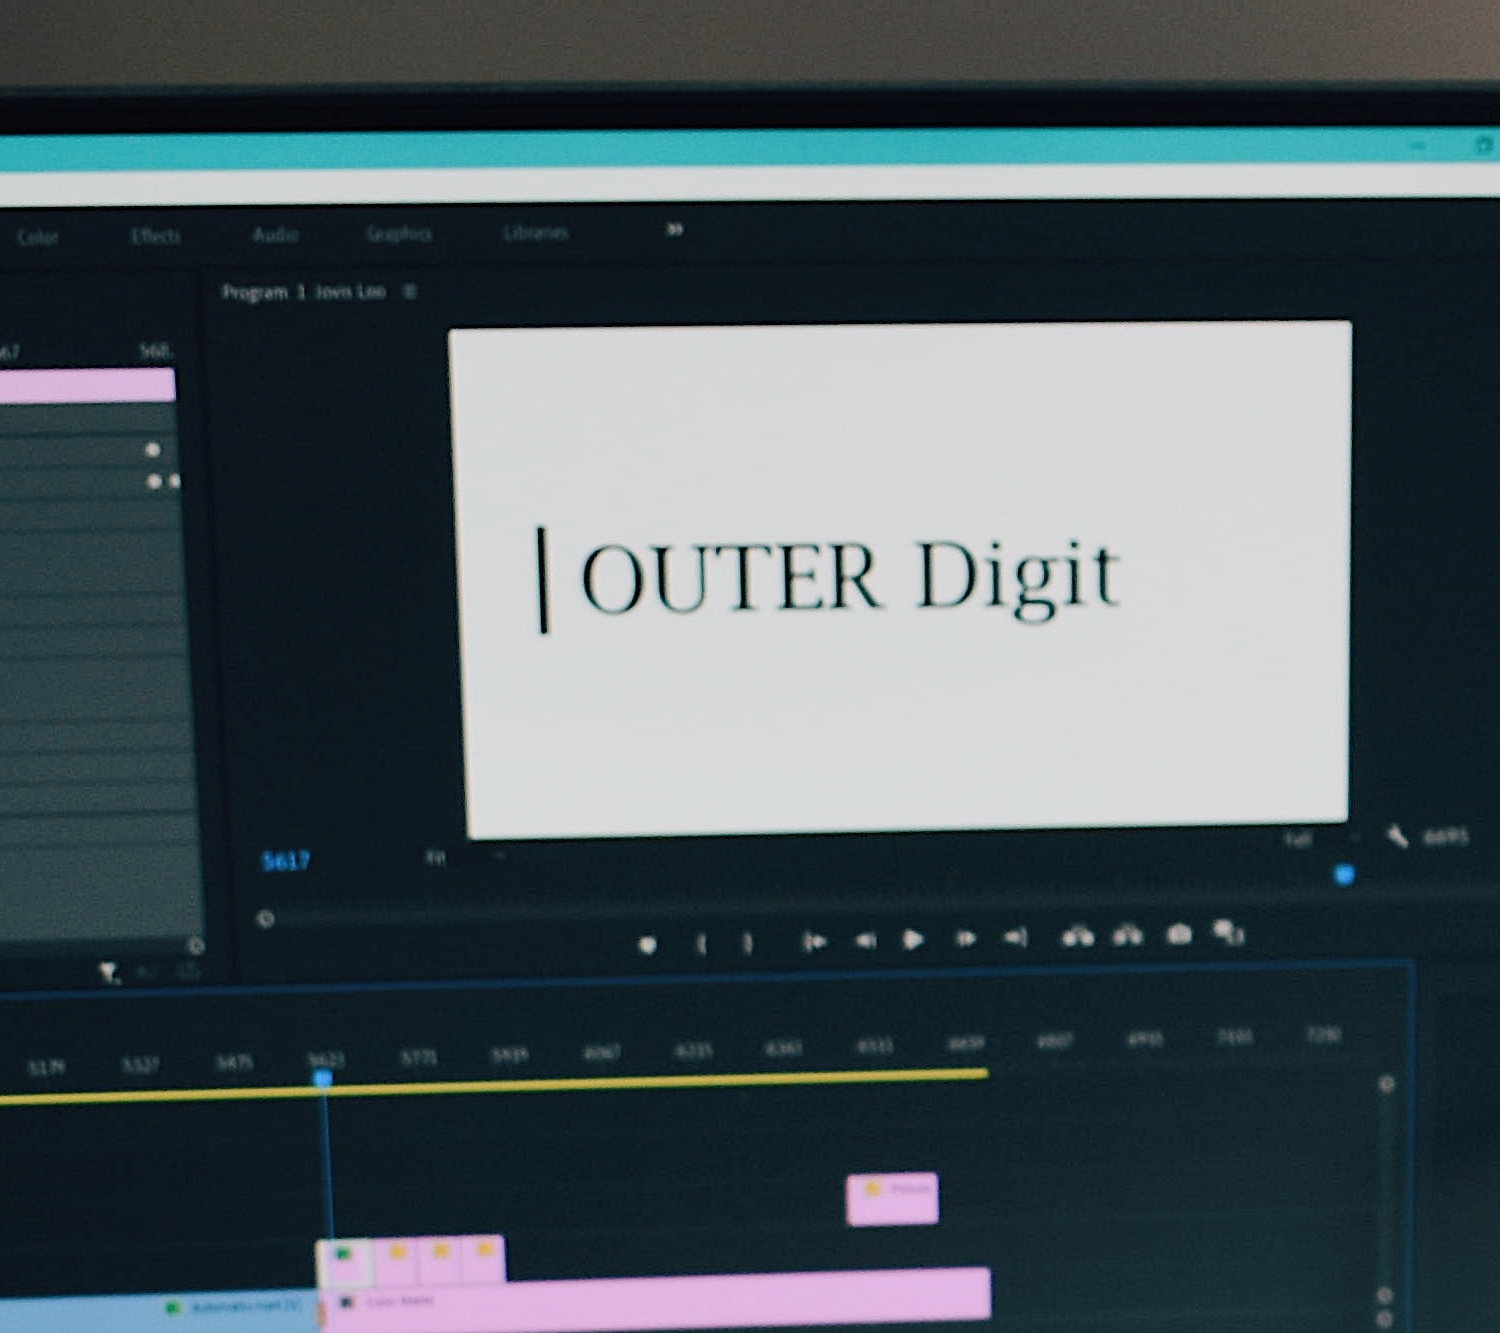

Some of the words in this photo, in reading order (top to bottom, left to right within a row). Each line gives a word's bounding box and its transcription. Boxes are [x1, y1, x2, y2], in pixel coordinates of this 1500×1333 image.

[15, 227, 60, 247] Color
[580, 540, 889, 617] OUTER
[913, 538, 1124, 626] Digit
